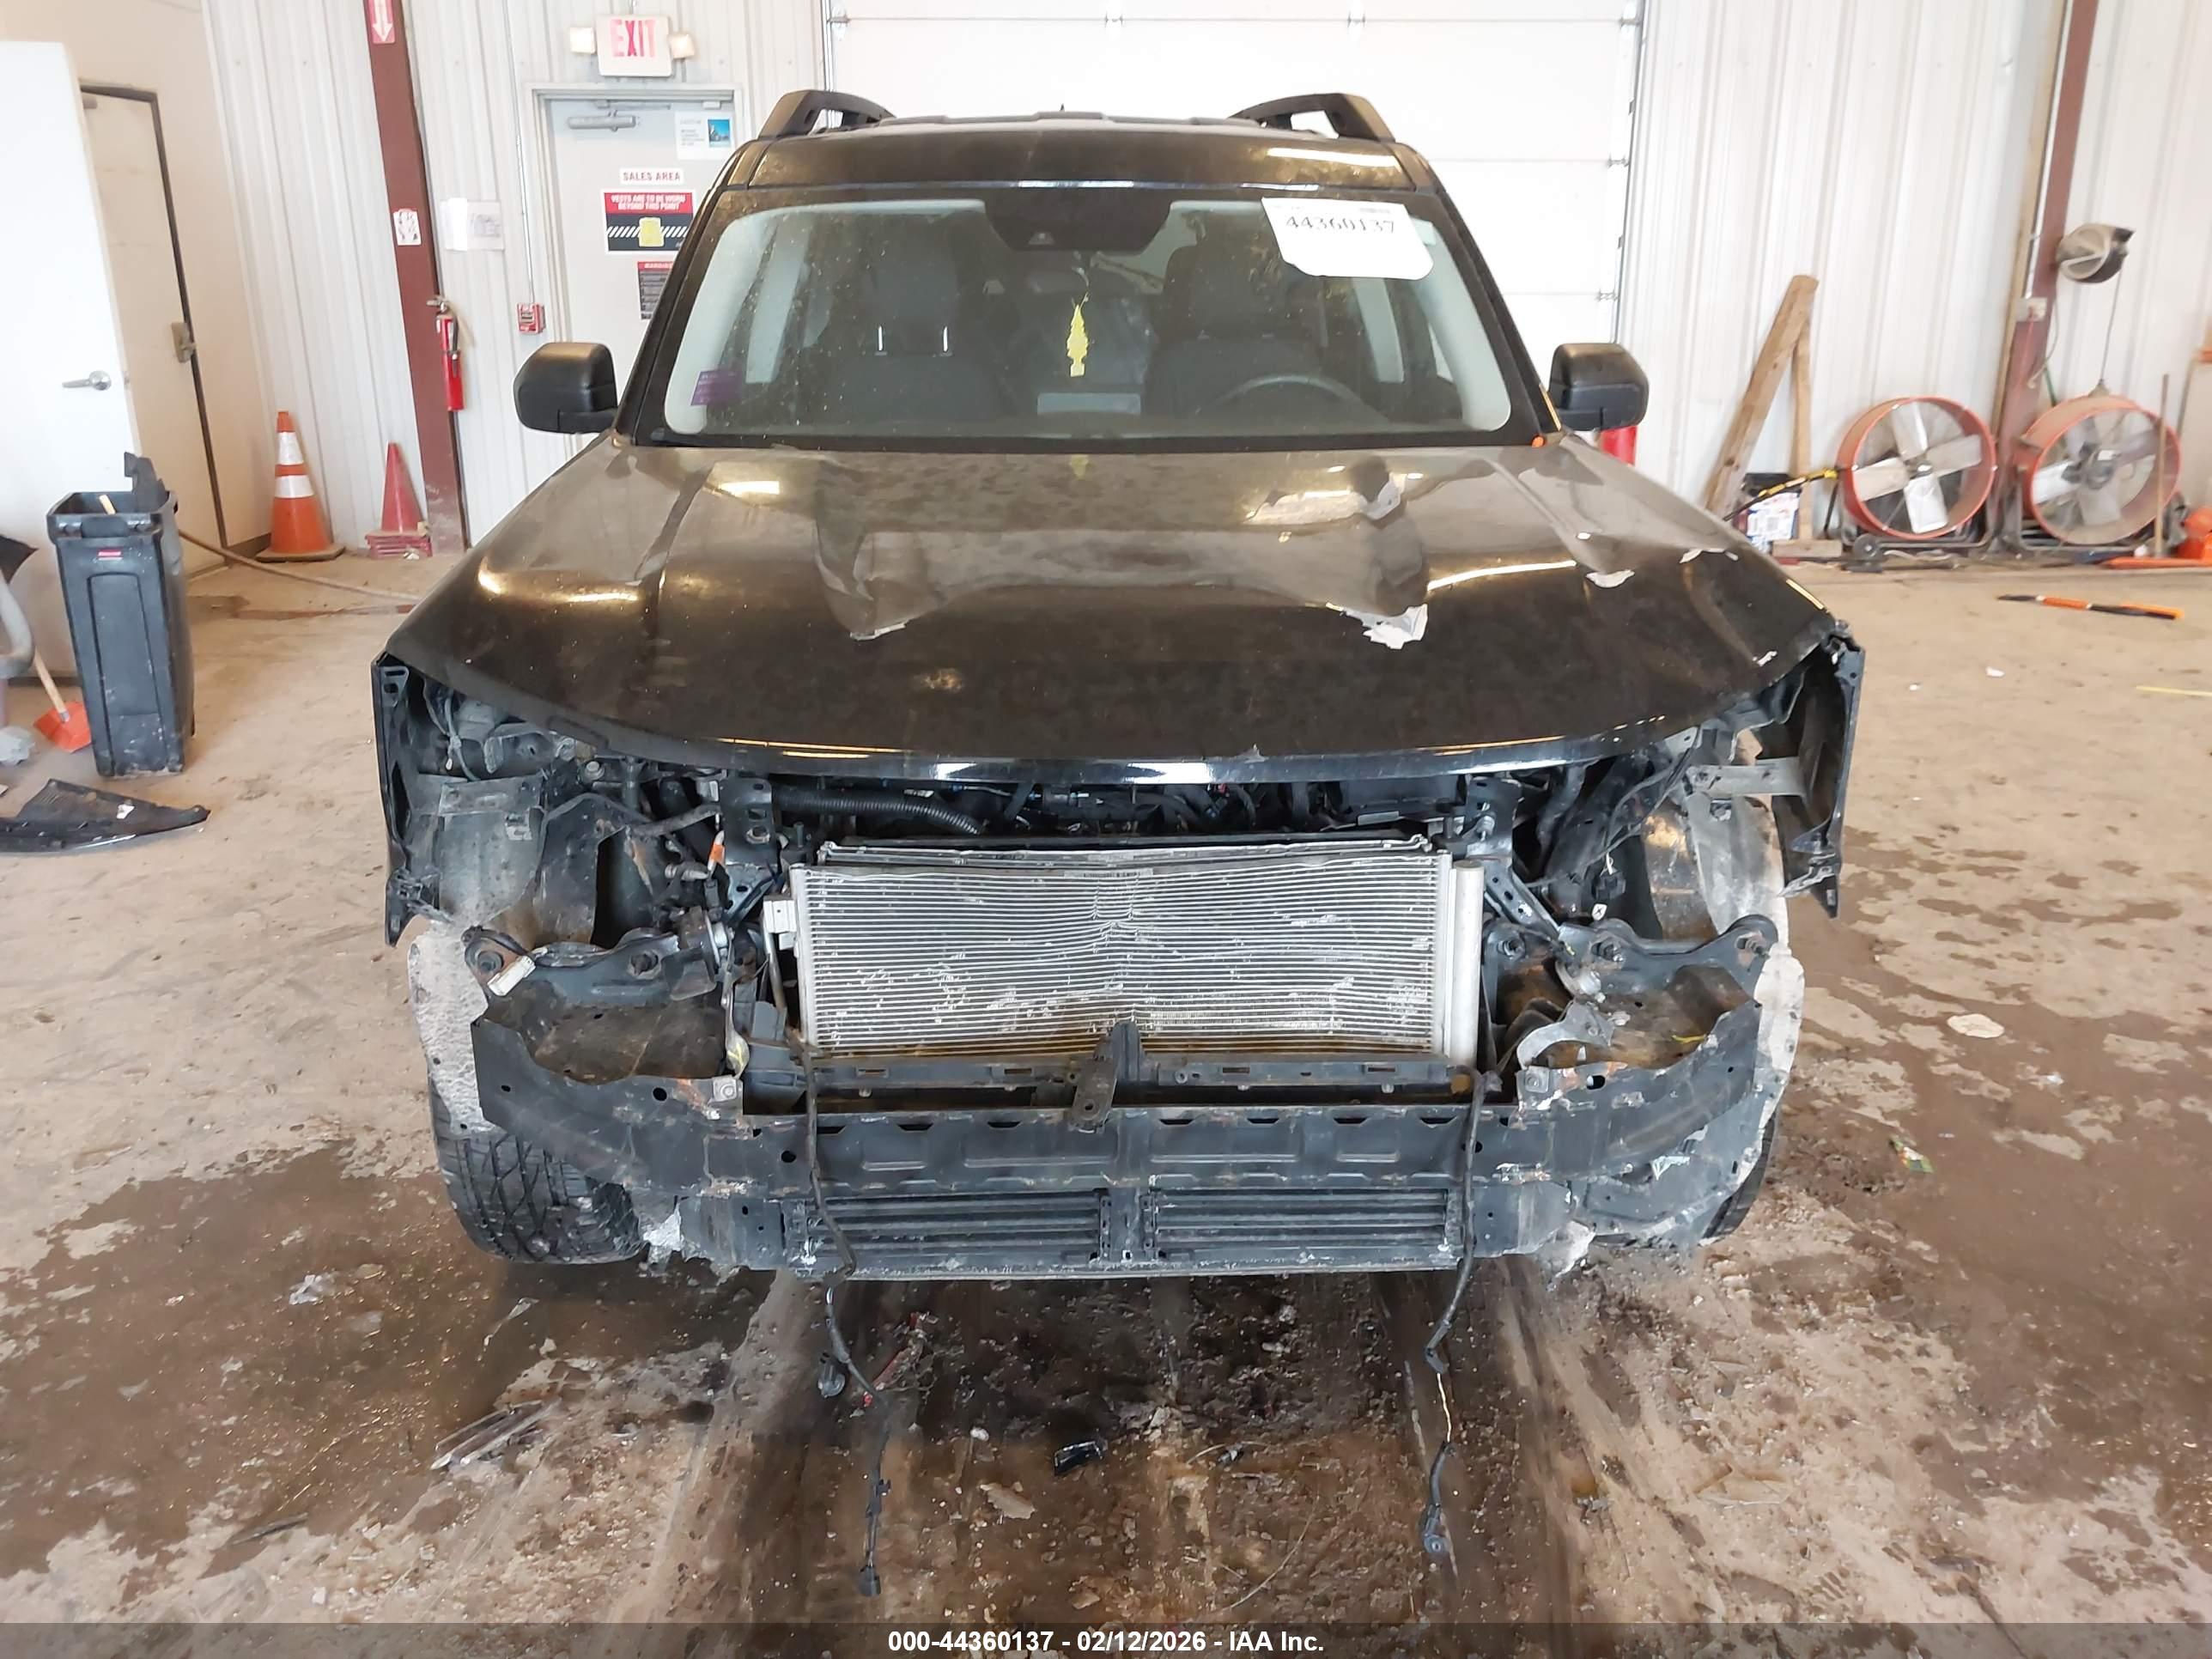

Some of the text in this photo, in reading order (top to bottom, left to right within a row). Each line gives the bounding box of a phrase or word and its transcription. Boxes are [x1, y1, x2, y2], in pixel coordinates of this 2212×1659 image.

[610, 19, 657, 58] EXIT
[623, 172, 681, 181] SALES AREA
[1285, 216, 1395, 234] 44360137
